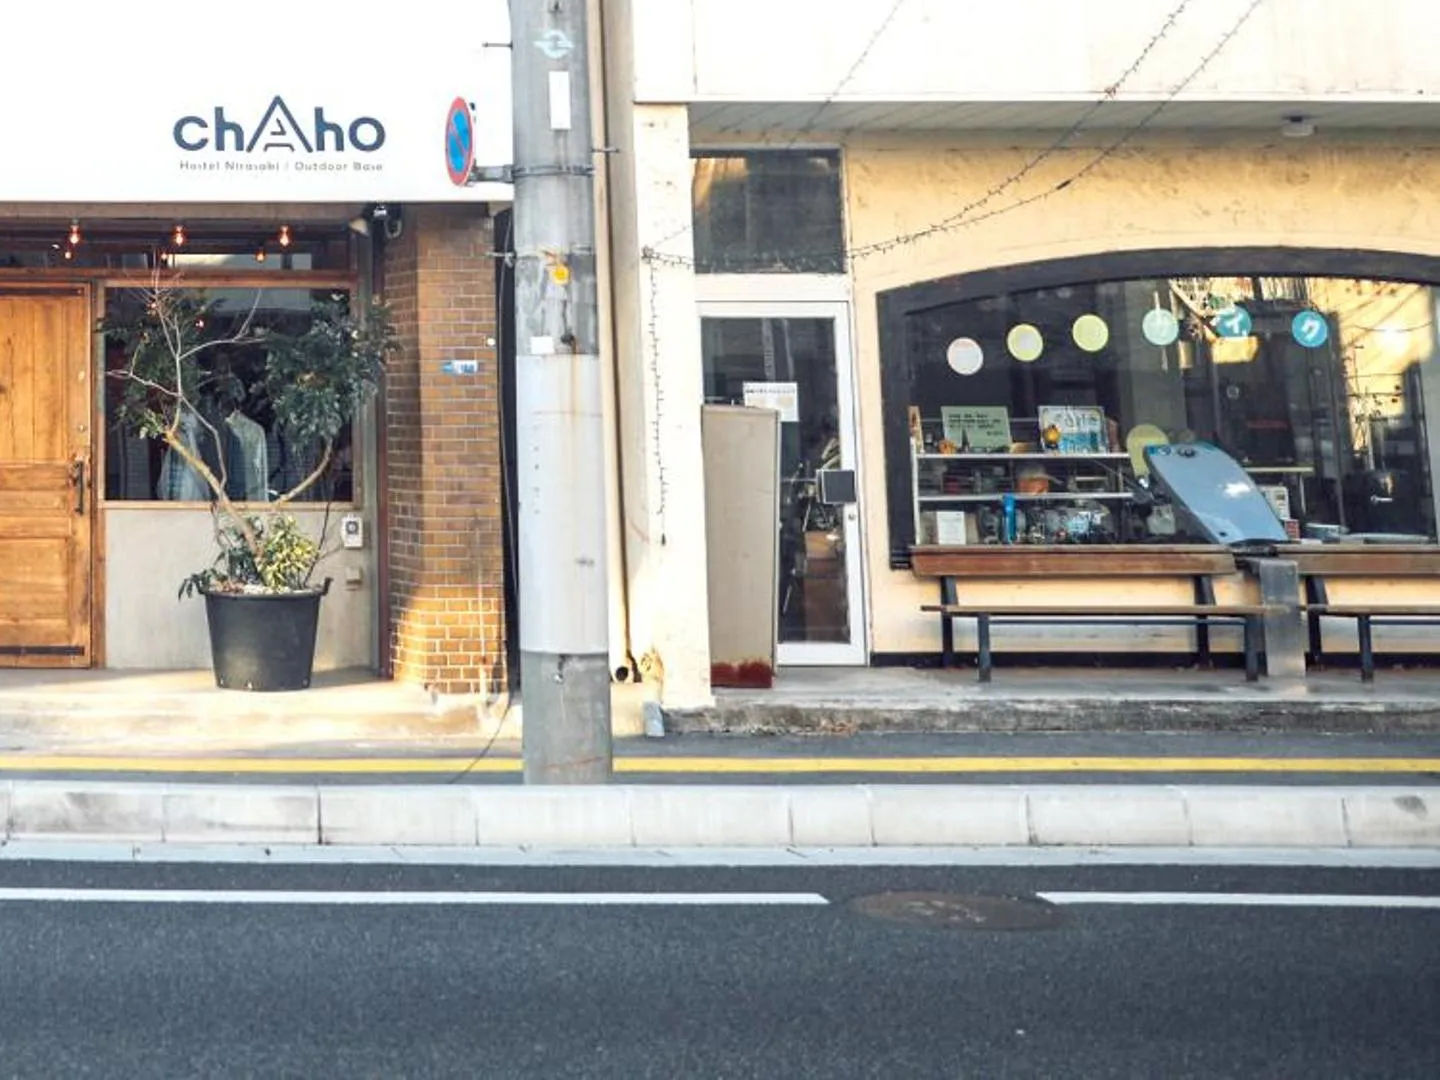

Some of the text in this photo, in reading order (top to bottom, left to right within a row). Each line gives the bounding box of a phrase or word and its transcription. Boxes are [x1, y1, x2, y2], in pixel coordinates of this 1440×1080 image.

[179, 160, 220, 172] Hostel
[294, 160, 349, 172] Outdoor
[352, 161, 384, 172] Base
